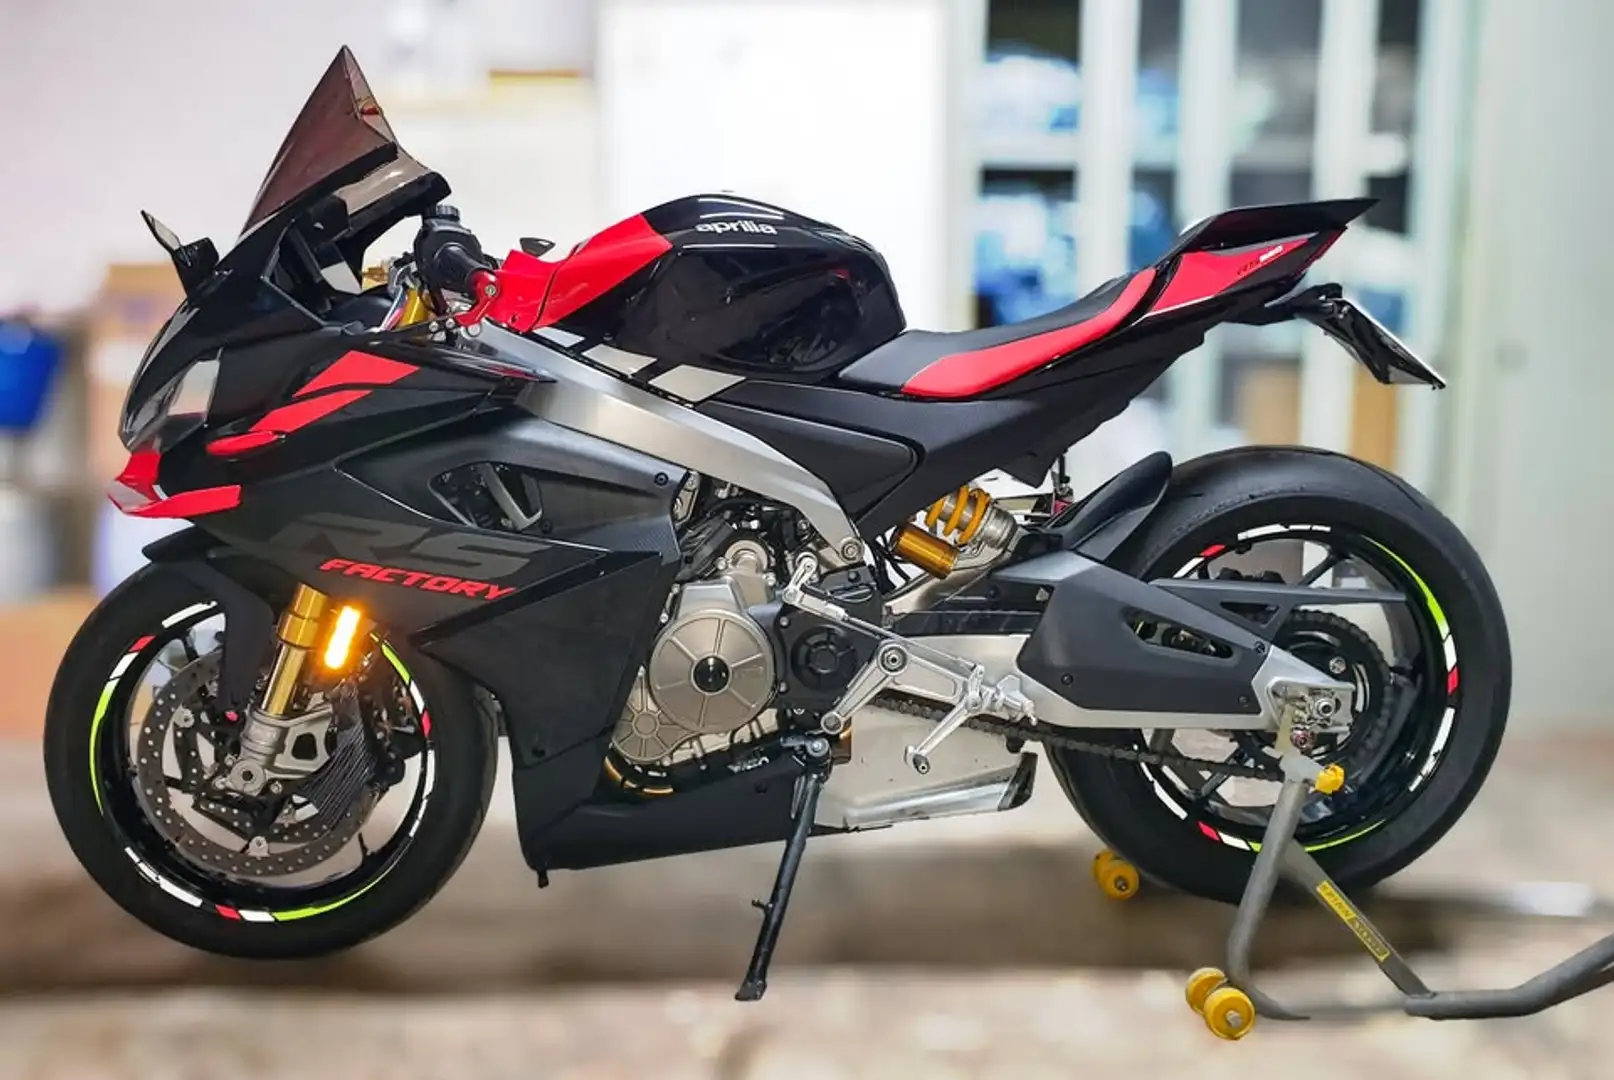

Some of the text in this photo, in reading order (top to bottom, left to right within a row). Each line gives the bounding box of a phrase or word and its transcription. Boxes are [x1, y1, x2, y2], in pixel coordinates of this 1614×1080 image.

[695, 220, 778, 235] aprilia
[267, 512, 552, 580] RS
[319, 558, 516, 600] FACTORY
